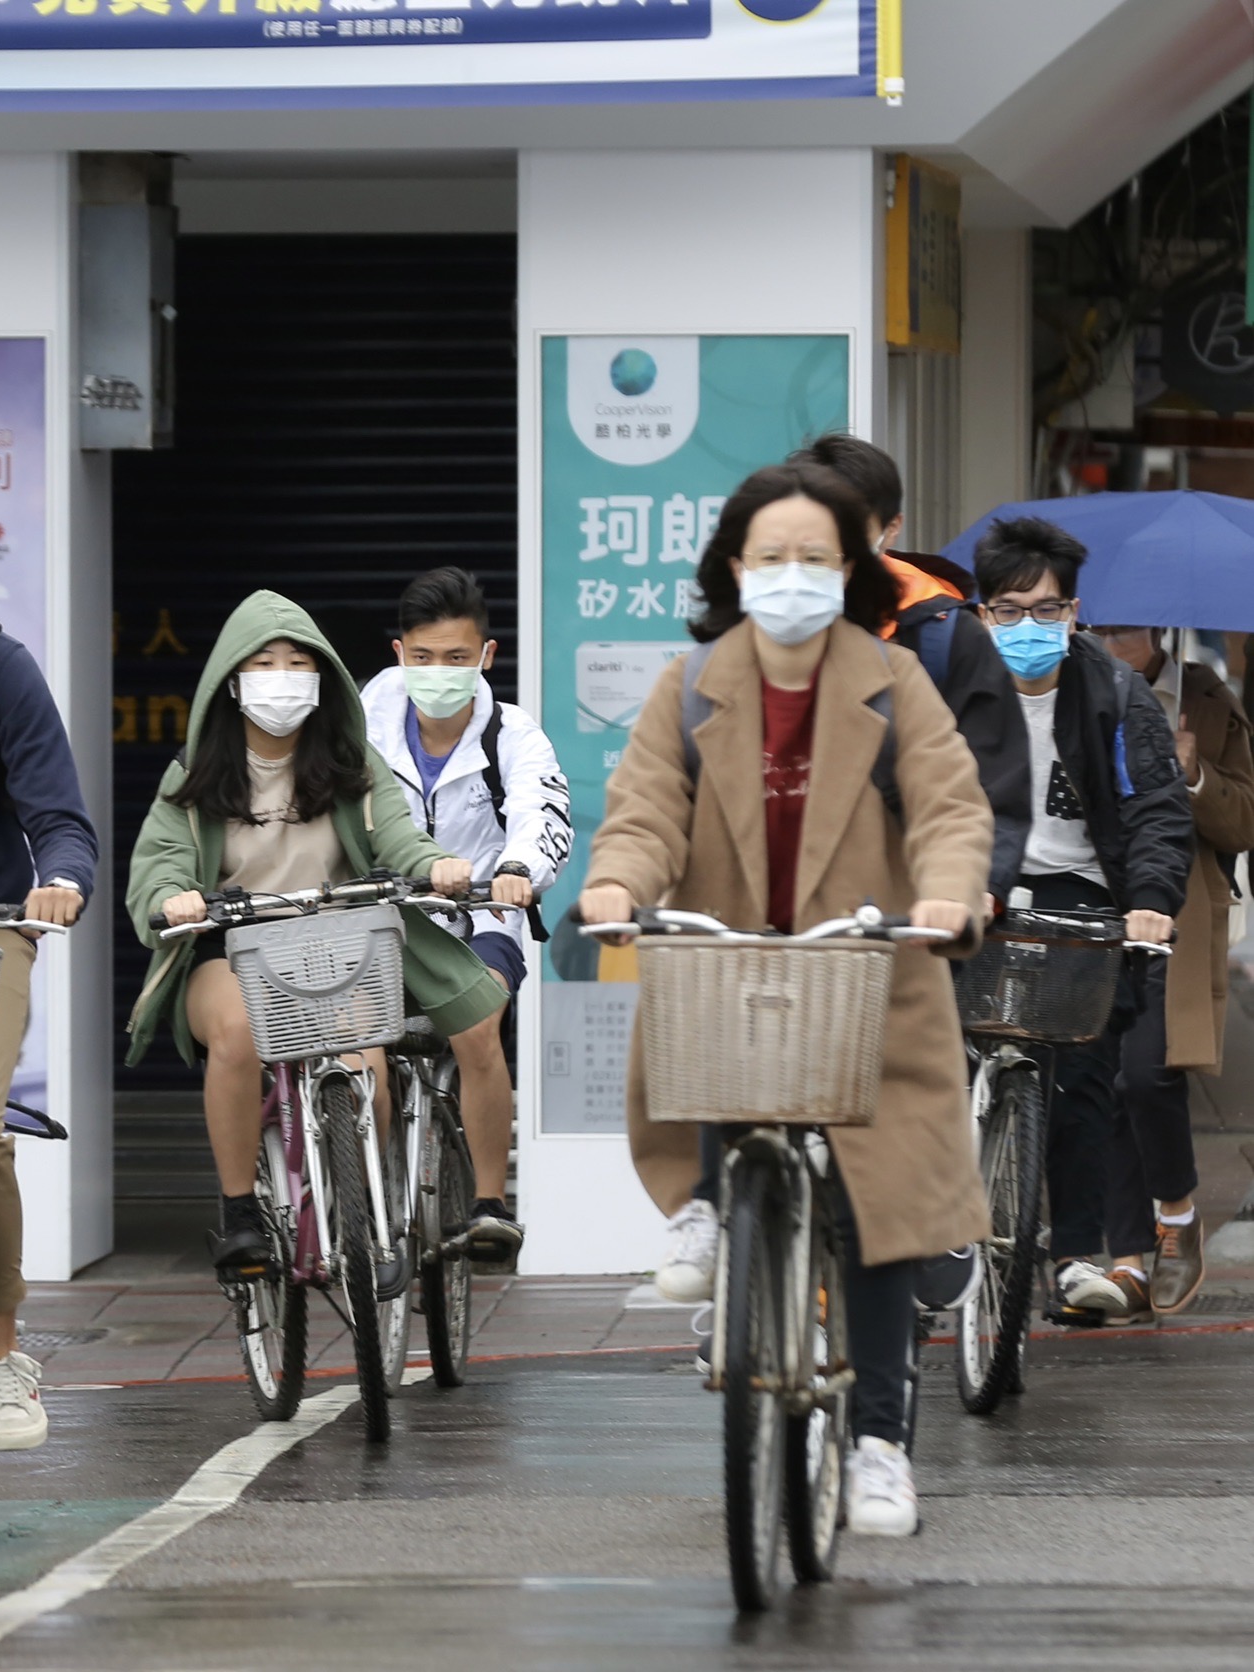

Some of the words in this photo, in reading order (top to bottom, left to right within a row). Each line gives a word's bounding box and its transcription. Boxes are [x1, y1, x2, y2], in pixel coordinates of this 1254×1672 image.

[595, 403, 672, 417] CooperVision
[595, 423, 672, 438] 酷柏光學
[588, 662, 622, 672] clariti
